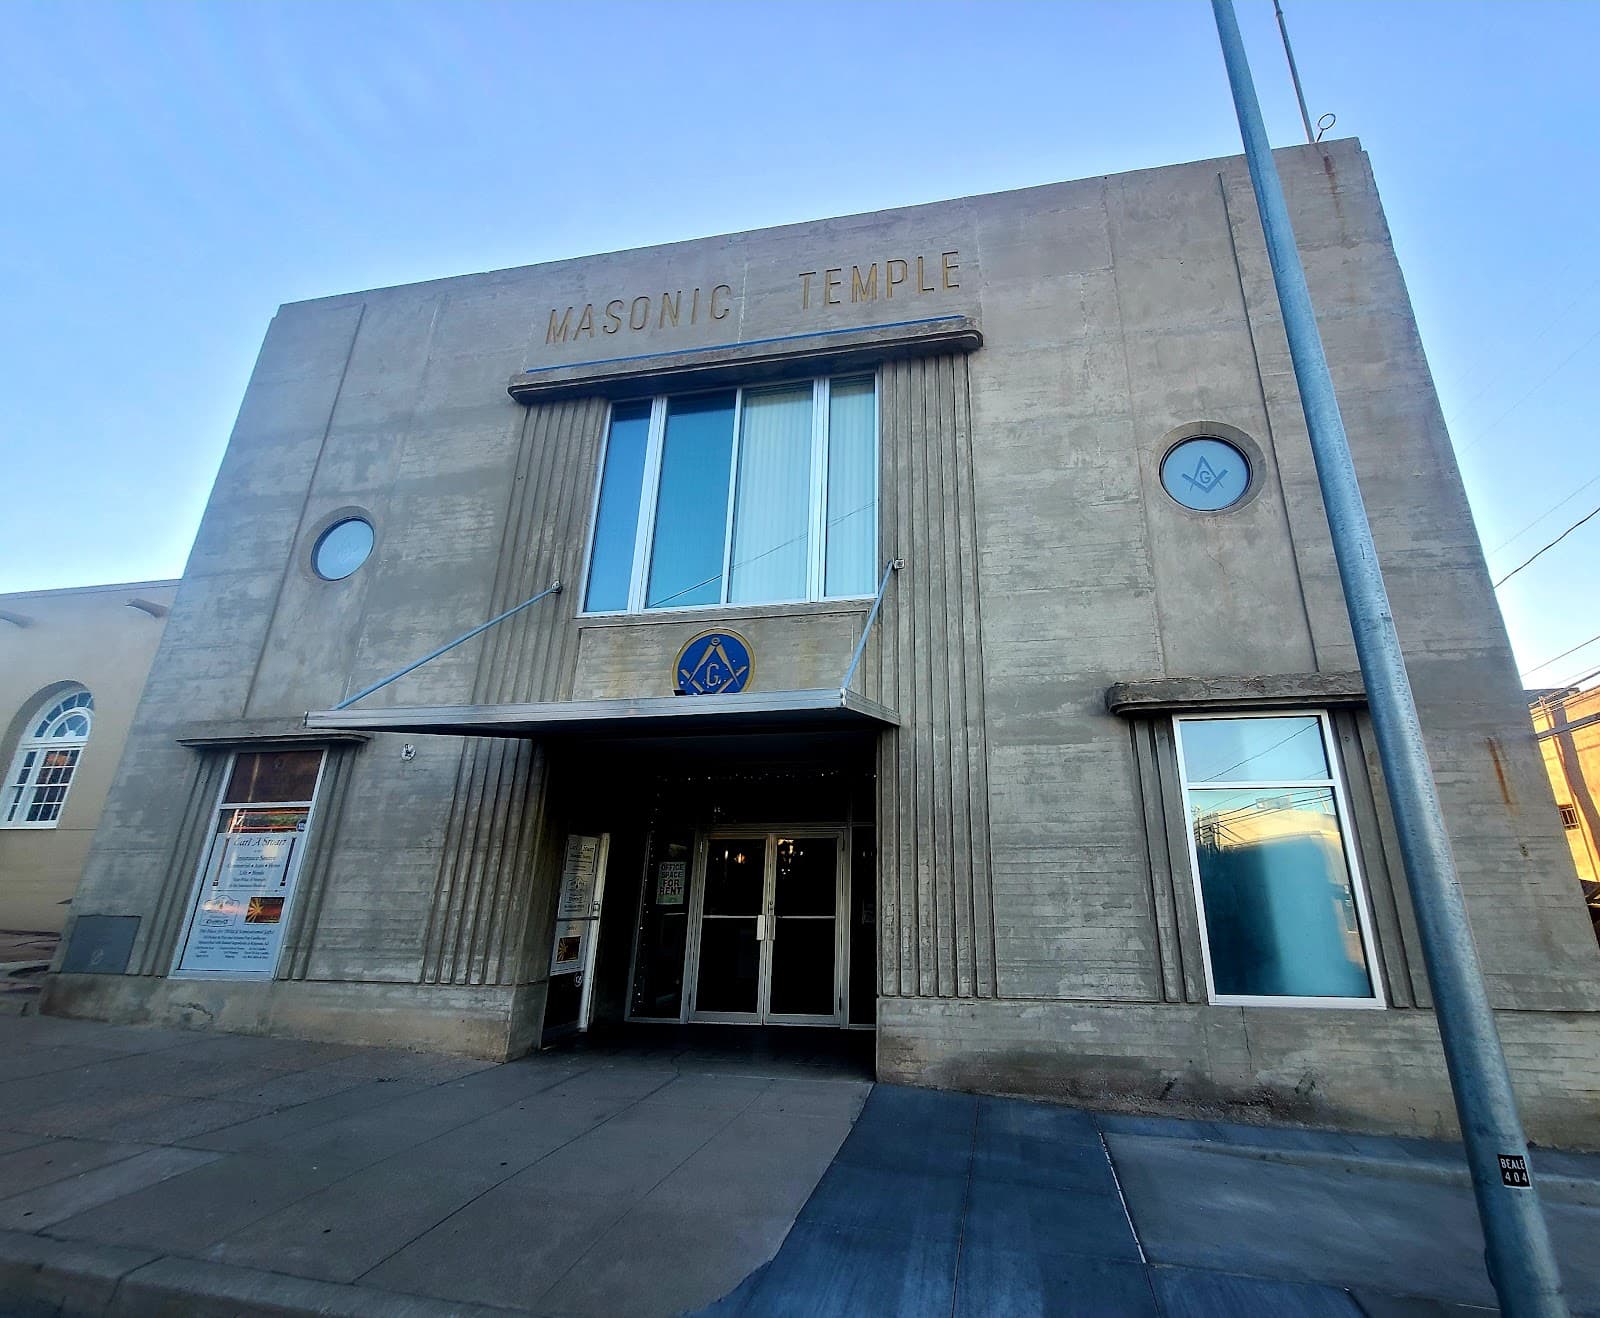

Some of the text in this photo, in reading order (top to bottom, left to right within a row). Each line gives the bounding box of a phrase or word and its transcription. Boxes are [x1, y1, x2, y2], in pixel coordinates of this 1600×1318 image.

[546, 251, 960, 345] MASONIC TEMPLE
[1199, 470, 1211, 484] G
[706, 663, 719, 687] G
[661, 863, 685, 871] OFFICE
[661, 871, 684, 879] SPACE
[663, 879, 680, 887] FOR
[660, 886, 683, 896] RENT
[1500, 1158, 1525, 1170] BEALE
[1505, 1172, 1528, 1182] 404
